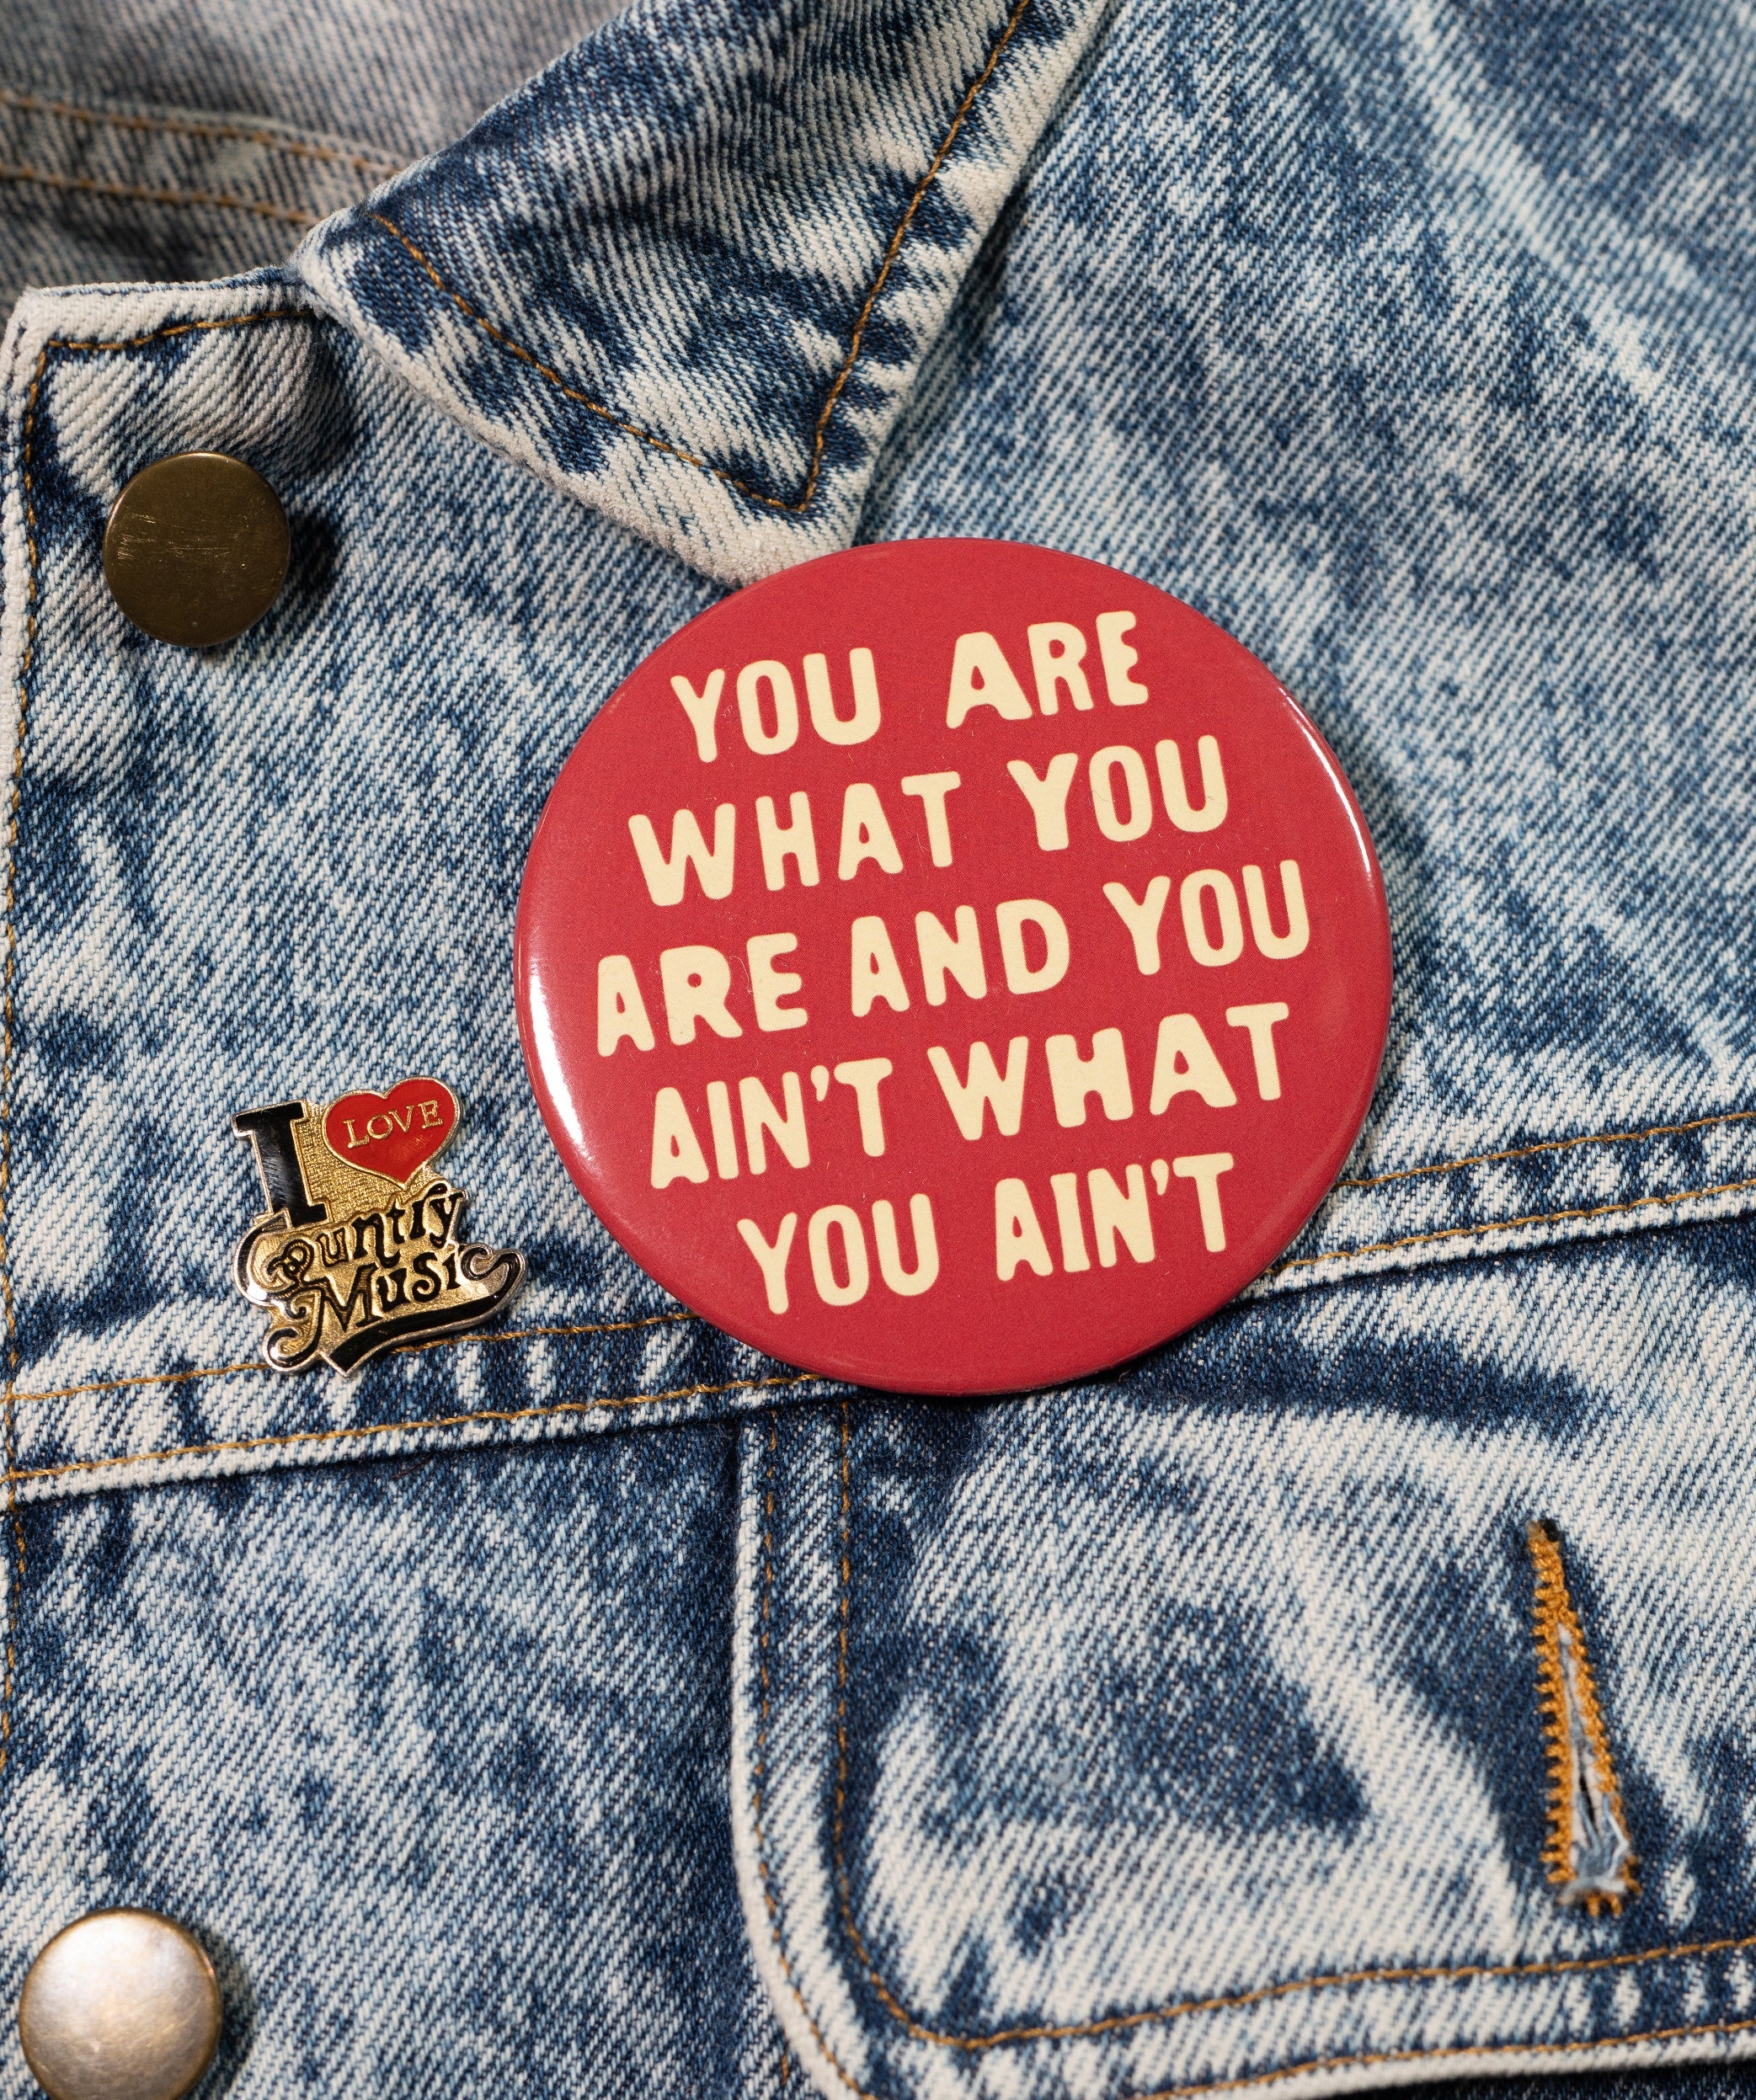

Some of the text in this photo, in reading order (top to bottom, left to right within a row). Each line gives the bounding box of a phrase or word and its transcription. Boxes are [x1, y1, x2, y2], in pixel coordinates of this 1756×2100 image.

[670, 611, 1148, 763] YOU ARE
[628, 735, 1228, 906] WHAT YOU
[597, 860, 1310, 1057] ARE AND YOU
[235, 1099, 443, 1222] I LOVE
[651, 1002, 1289, 1189] AIN'T WHAT
[234, 1181, 467, 1302] Country
[267, 1243, 522, 1366] Music
[737, 1153, 1234, 1314] YOU AIN'T
